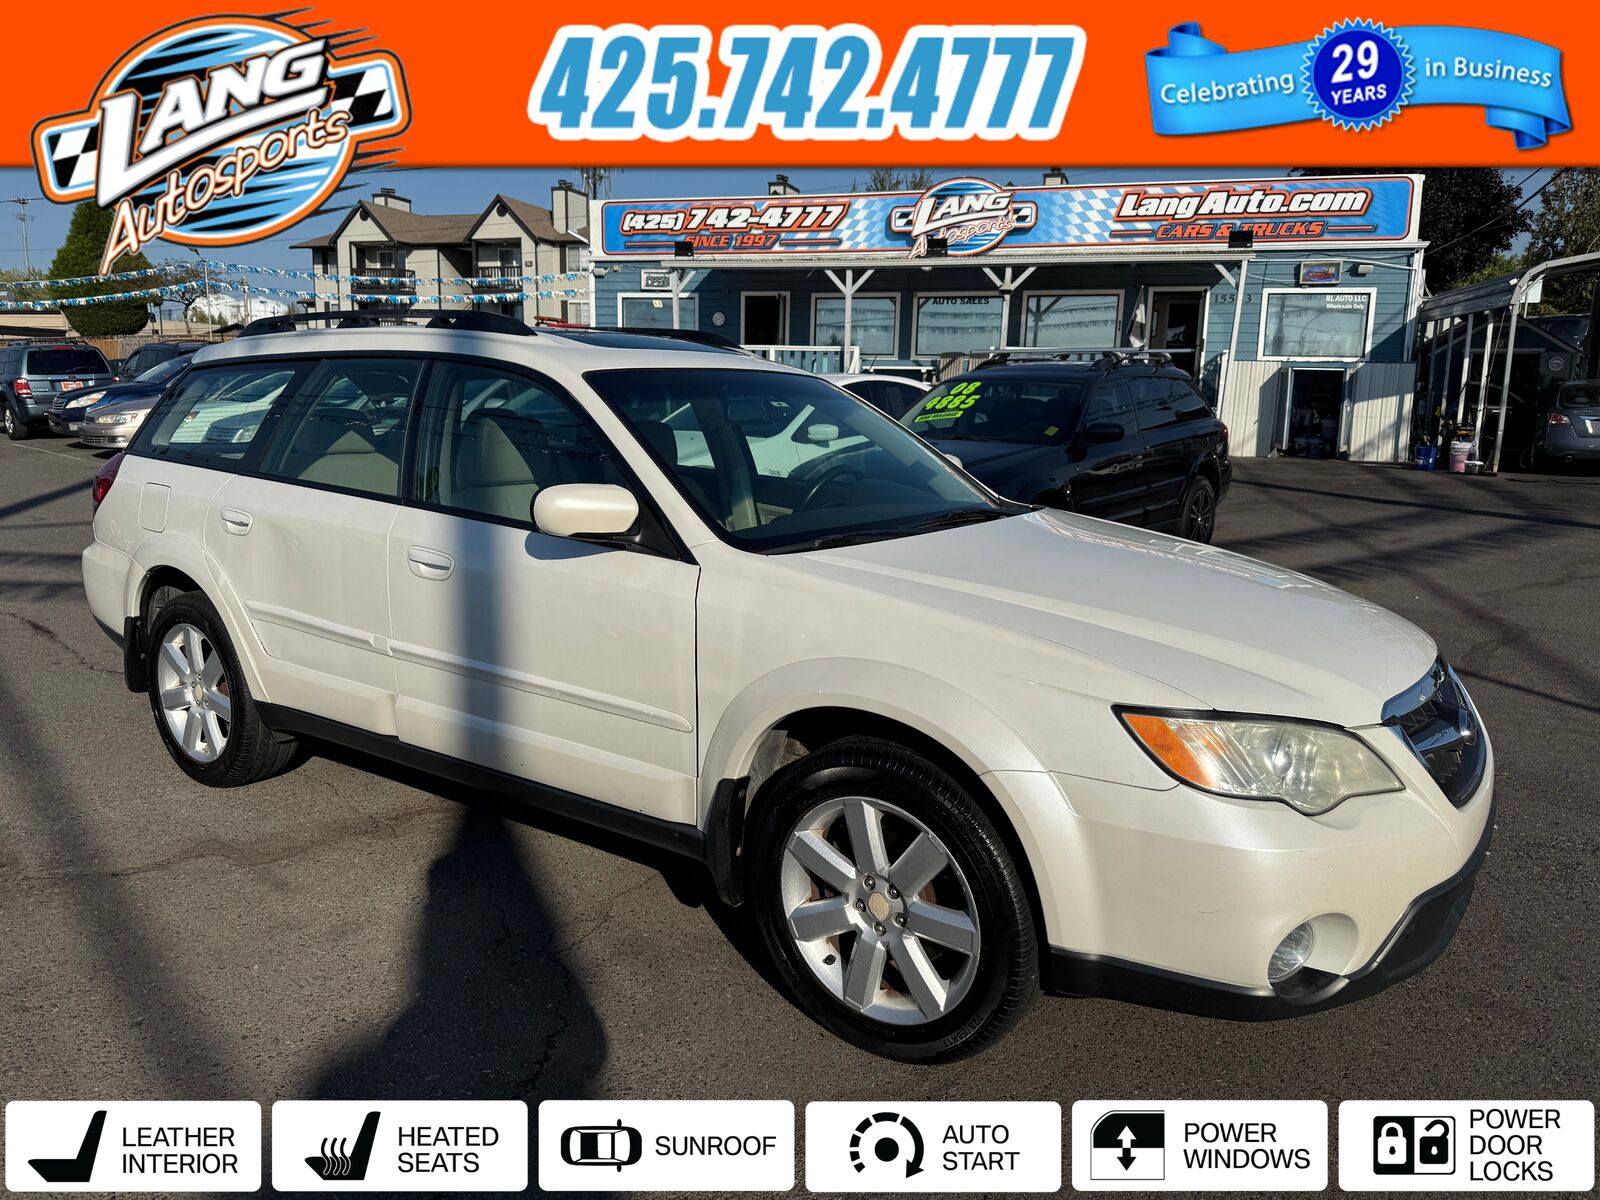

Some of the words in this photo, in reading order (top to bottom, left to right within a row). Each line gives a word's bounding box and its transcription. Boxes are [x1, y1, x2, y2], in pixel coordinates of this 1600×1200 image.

[1117, 190, 1368, 219] LangAuto.com
[622, 211, 685, 231] (425)
[685, 204, 847, 230] 742-4777
[912, 192, 1014, 237] LANG
[1155, 223, 1214, 238] CARS
[1216, 223, 1233, 237] &
[684, 235, 731, 248] SINCE
[734, 234, 779, 248] 1997
[932, 296, 957, 305] AUTO
[959, 296, 990, 305] SALES
[1214, 294, 1252, 304] 1553
[1334, 294, 1354, 302] AUTO
[1354, 294, 1368, 302] LLC
[1352, 303, 1365, 311] Only
[950, 381, 982, 395] 08
